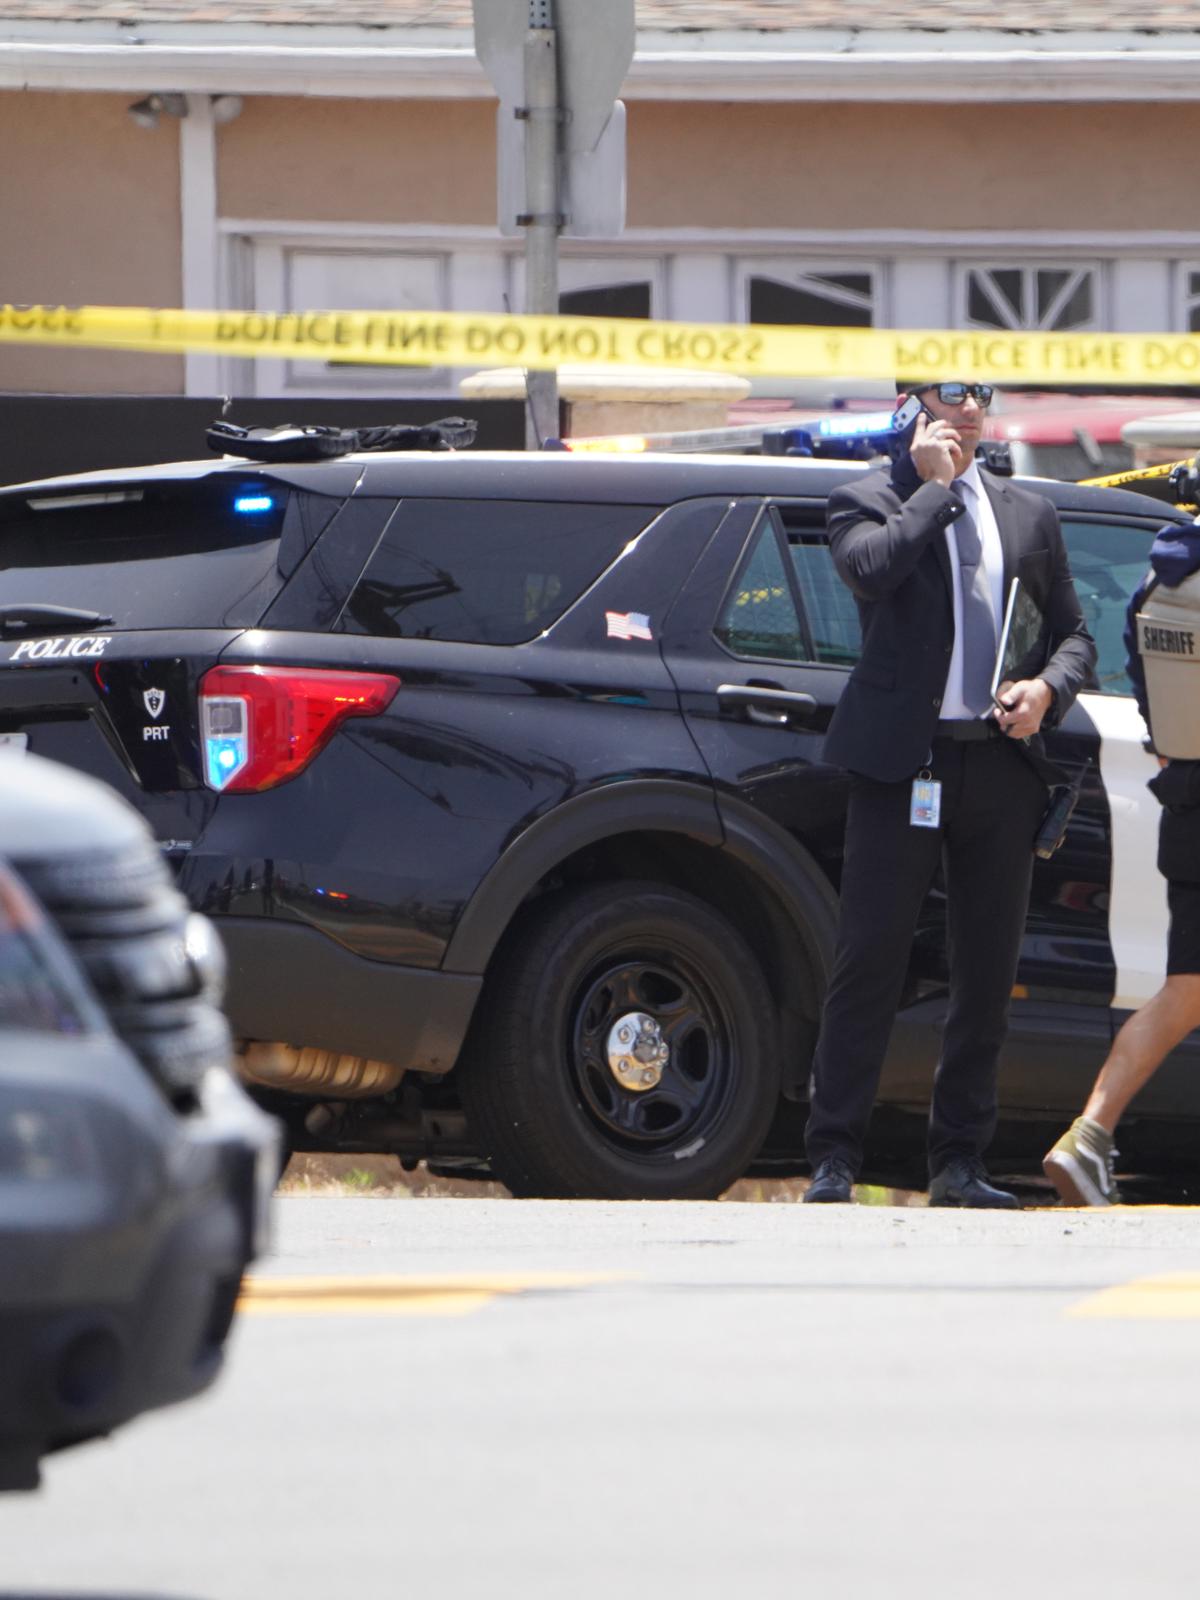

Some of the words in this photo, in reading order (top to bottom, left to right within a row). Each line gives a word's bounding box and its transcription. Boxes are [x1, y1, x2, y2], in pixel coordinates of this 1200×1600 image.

[9, 636, 112, 661] POLICE
[1143, 626, 1195, 656] SHERIFF
[143, 725, 170, 741] PRT
